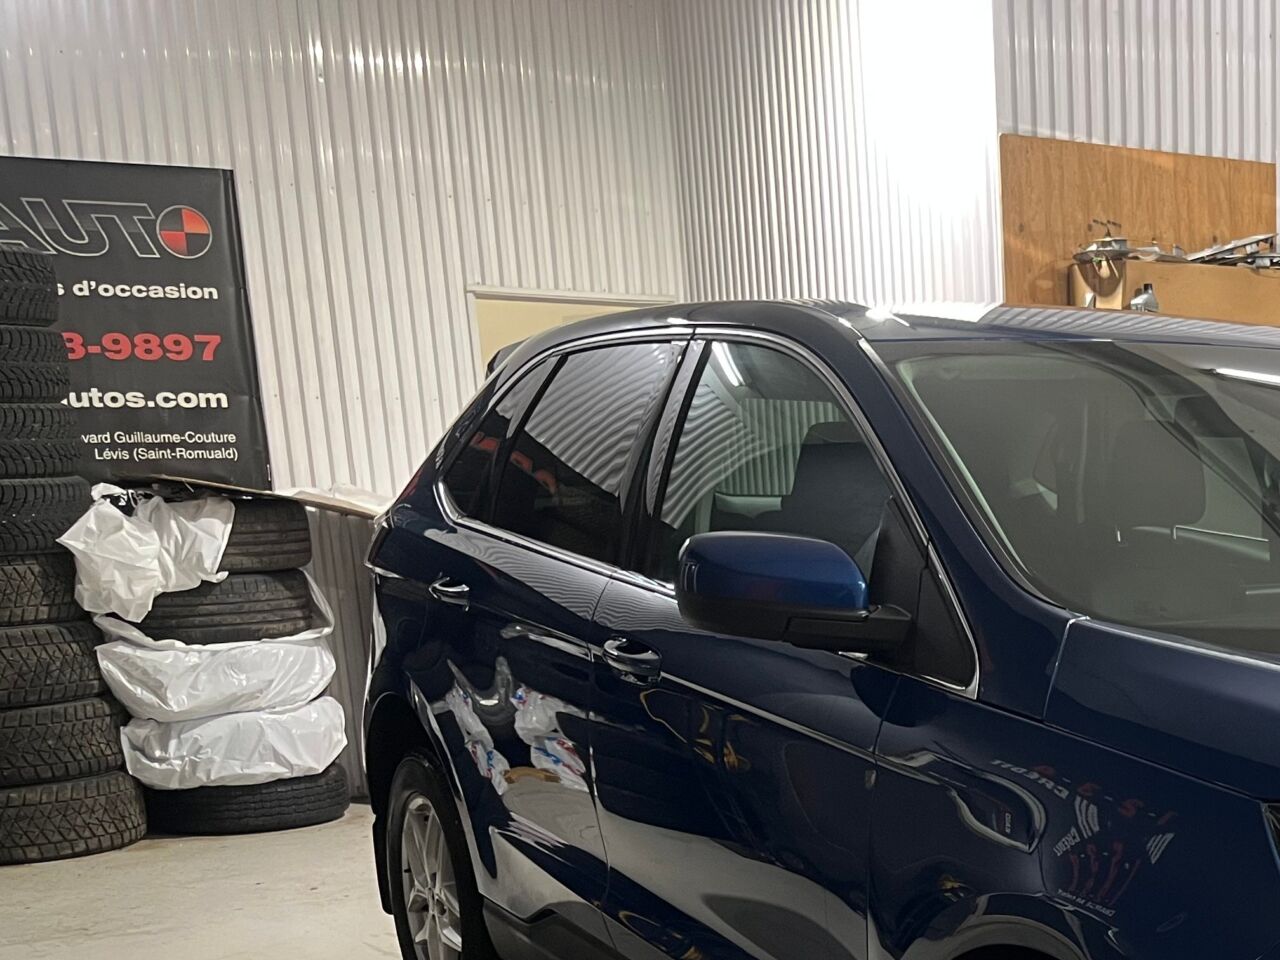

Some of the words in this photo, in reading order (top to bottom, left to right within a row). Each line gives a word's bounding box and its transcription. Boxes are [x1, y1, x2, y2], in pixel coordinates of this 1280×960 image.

[72, 280, 219, 300] d'occasion
[61, 332, 222, 361] 3-9897
[61, 387, 229, 409] utos.com
[114, 431, 237, 444] Guillaume-Couture
[94, 447, 130, 460] Lévis
[133, 447, 239, 462] (Saint-Romuald)
